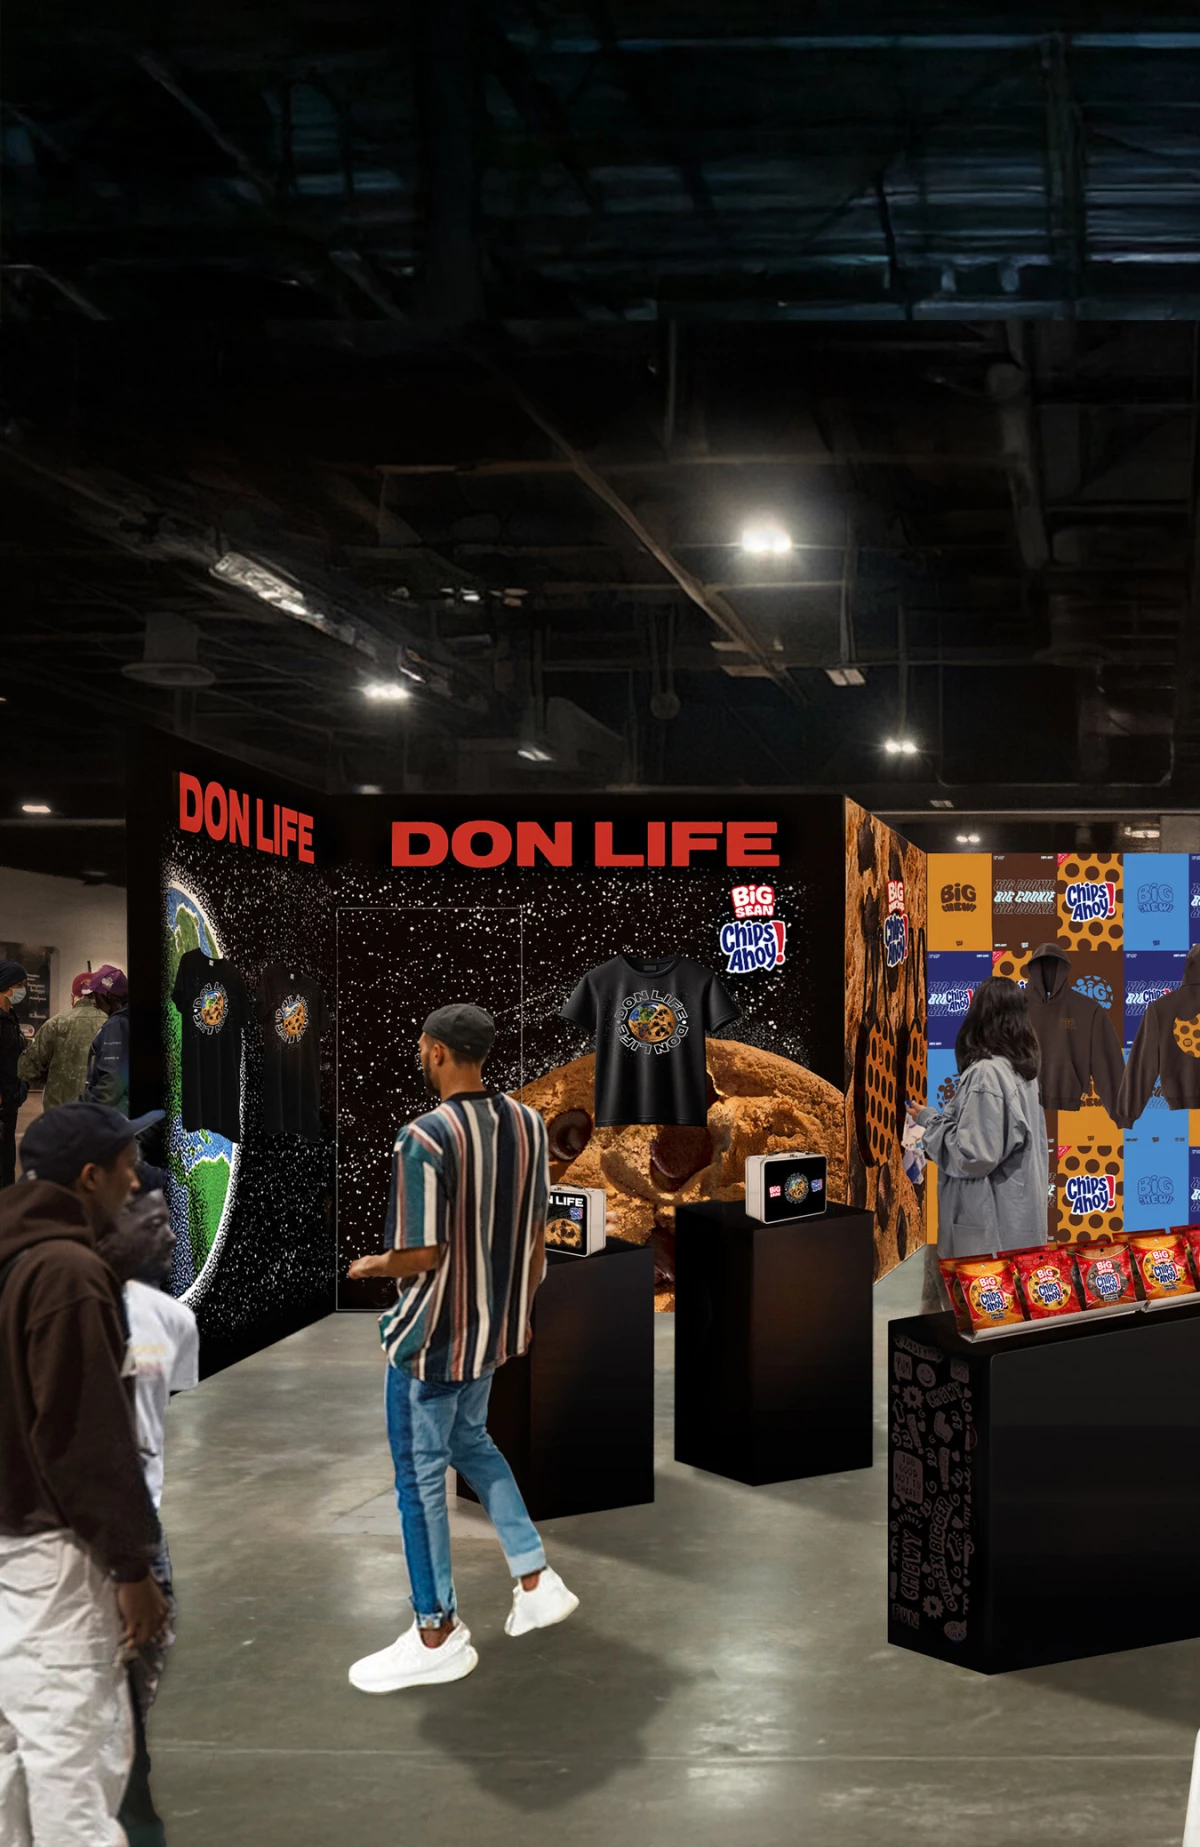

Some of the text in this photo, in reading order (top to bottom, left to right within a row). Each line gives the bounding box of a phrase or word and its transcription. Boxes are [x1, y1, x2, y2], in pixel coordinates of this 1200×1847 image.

[179, 772, 315, 864] DON LIFE
[391, 820, 780, 867] DON LIFE
[732, 885, 773, 907] BiG
[941, 883, 976, 903] BiG
[994, 891, 1056, 903] BIG COOKIE
[1067, 883, 1106, 907] Chips
[1073, 883, 1115, 920] Ahoy!
[735, 904, 774, 917] SEAN
[722, 921, 775, 953] Chips
[729, 922, 785, 971] Ahoy!
[614, 990, 688, 1021] DON LIFE
[946, 990, 968, 1003] Chips
[1067, 1176, 1106, 1200] Chips
[1073, 1175, 1115, 1214] Ahoy!
[555, 1196, 584, 1207] LIFE
[1096, 1274, 1116, 1288] Chips
[1153, 1264, 1173, 1278] Chips
[981, 1292, 1001, 1306] Chips
[1039, 1284, 1058, 1298] Chips
